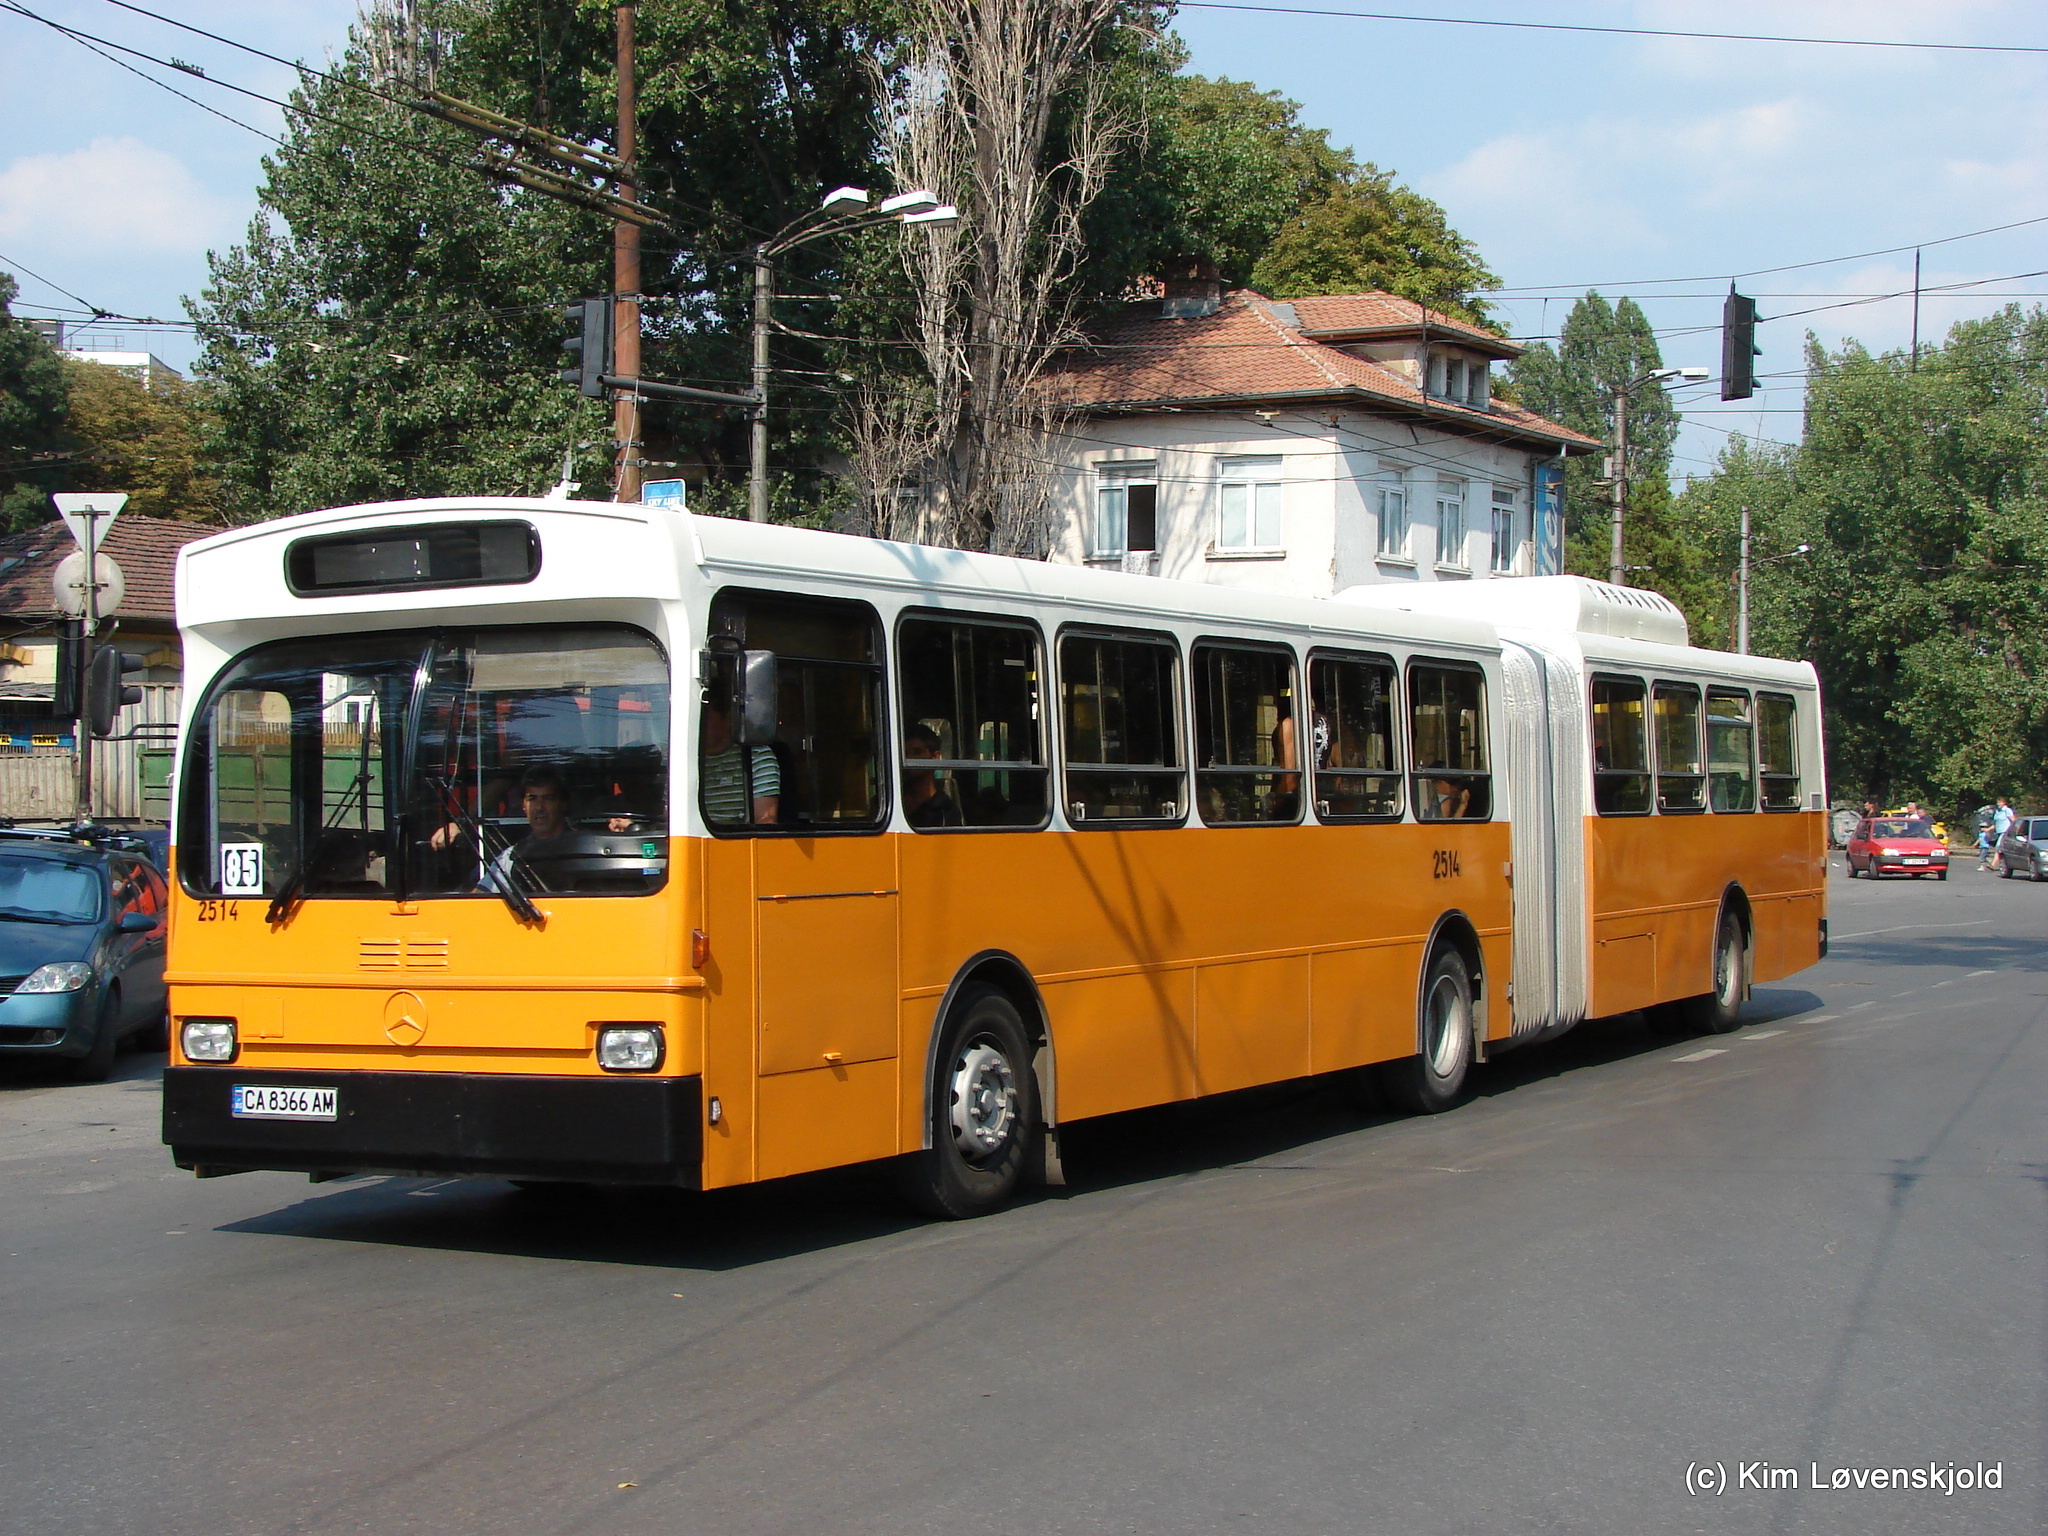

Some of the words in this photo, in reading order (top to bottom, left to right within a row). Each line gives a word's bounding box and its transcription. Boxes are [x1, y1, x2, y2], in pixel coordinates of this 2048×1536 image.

[1433, 850, 1460, 878] 2514
[198, 900, 238, 921] 2514
[245, 1090, 265, 1110] CA
[269, 1091, 308, 1111] 8366
[312, 1092, 333, 1113] AM
